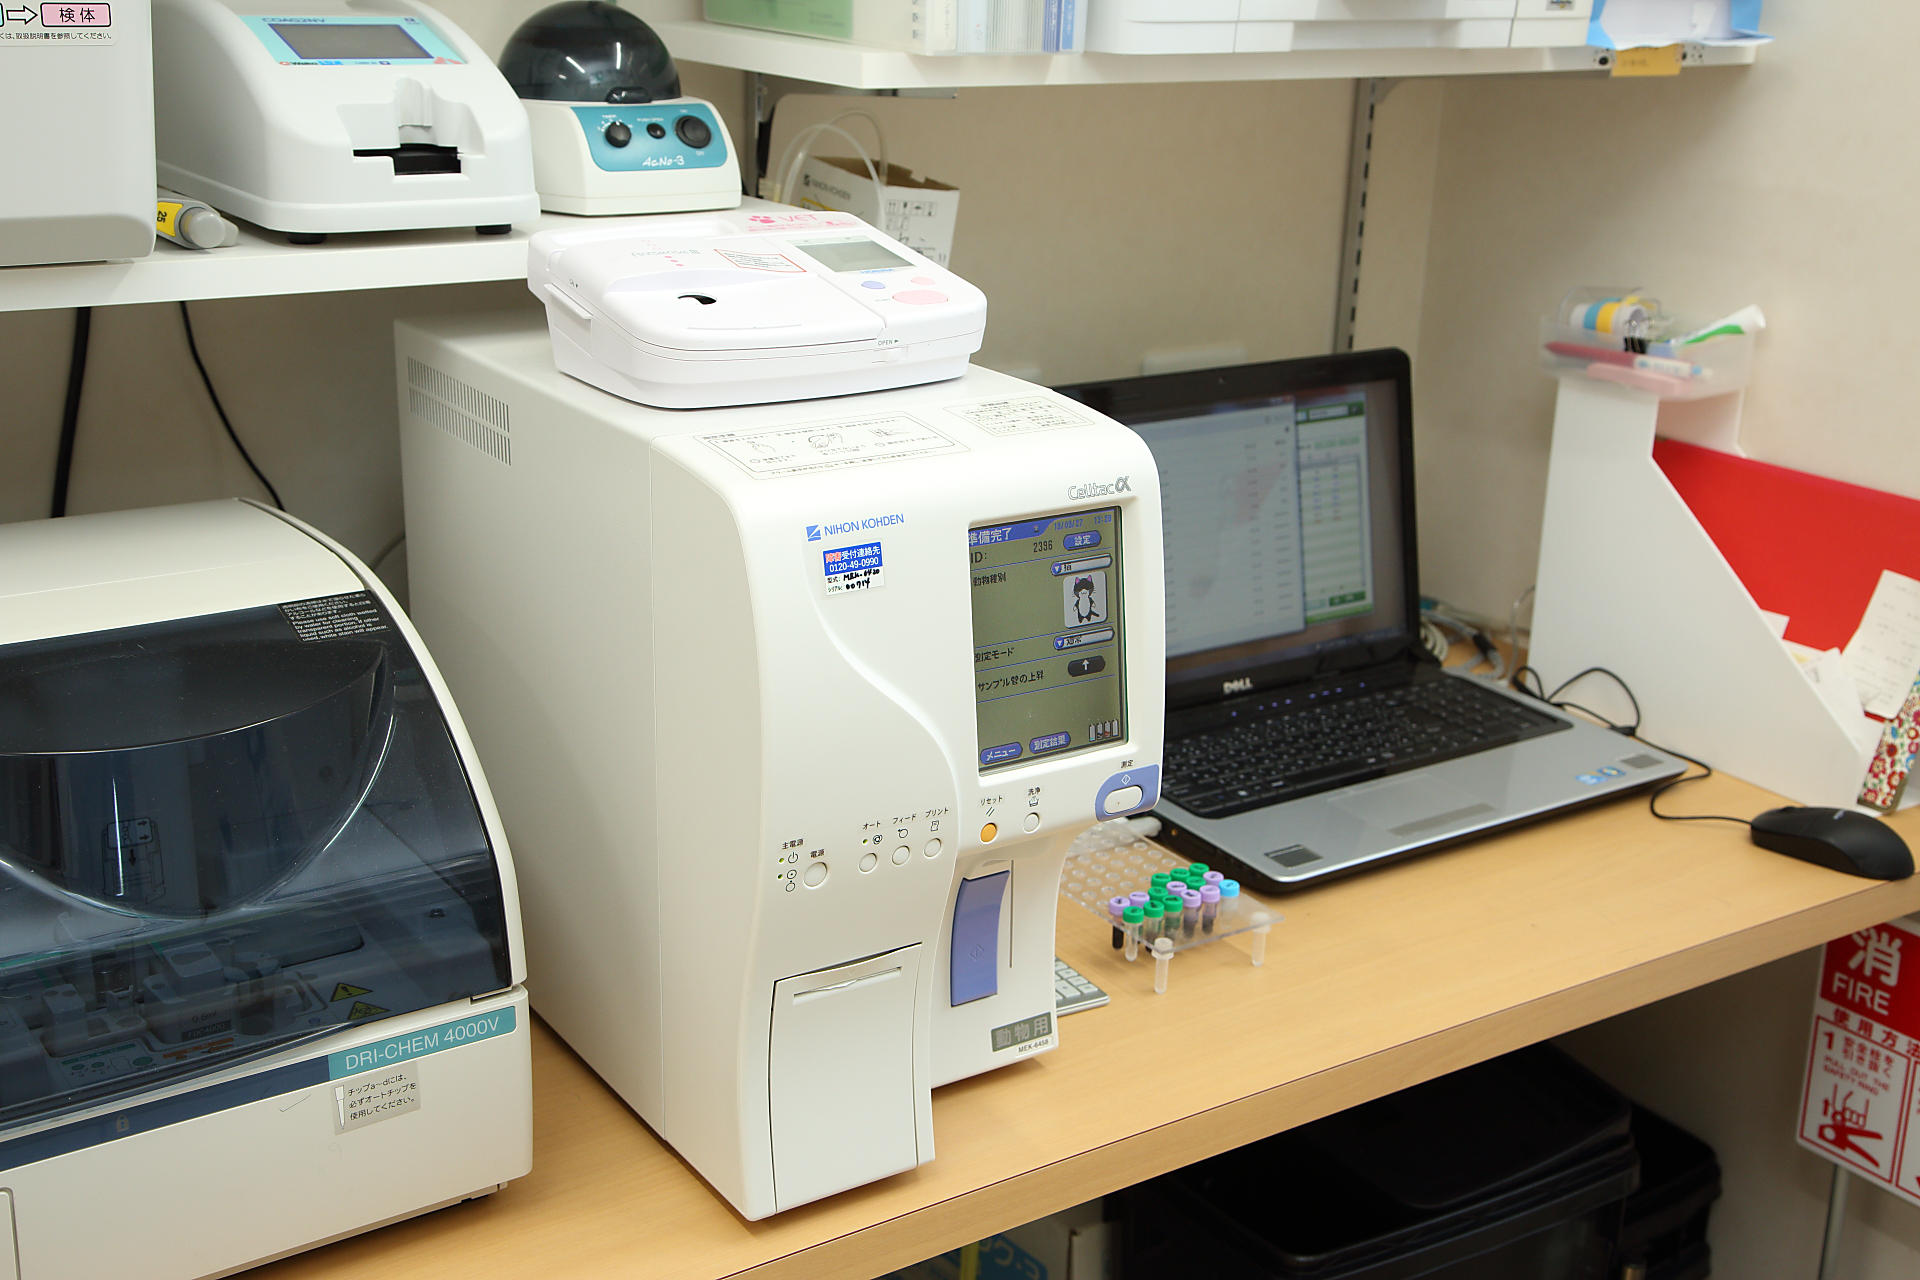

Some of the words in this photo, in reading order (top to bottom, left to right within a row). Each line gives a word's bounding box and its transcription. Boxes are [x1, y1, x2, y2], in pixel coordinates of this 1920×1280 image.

[59, 7, 96, 23] 検体
[157, 210, 167, 224] 25
[824, 521, 860, 536] NIHON
[861, 513, 905, 530] KOHDEN
[968, 527, 1012, 546] 準備完了
[970, 551, 988, 564] ID:
[1033, 540, 1053, 553] 2396
[829, 556, 879, 572] 0120-49-0990
[297, 623, 333, 633] transparent
[1223, 676, 1254, 695] DELL
[986, 748, 1016, 762] メニュー
[980, 795, 1003, 806] リセット
[892, 813, 918, 825] フィード
[925, 807, 950, 818] プリント
[862, 820, 881, 830] オート
[781, 838, 804, 850] 主電源
[809, 848, 825, 859] 電源
[1848, 927, 1902, 987] 消
[1832, 971, 1890, 1017] FIRE
[345, 1032, 439, 1070] DRI-CHEM
[443, 1016, 499, 1043] 4000V
[348, 1082, 416, 1108] 必ずオートチップを
[349, 1096, 415, 1121] 使用してください。
